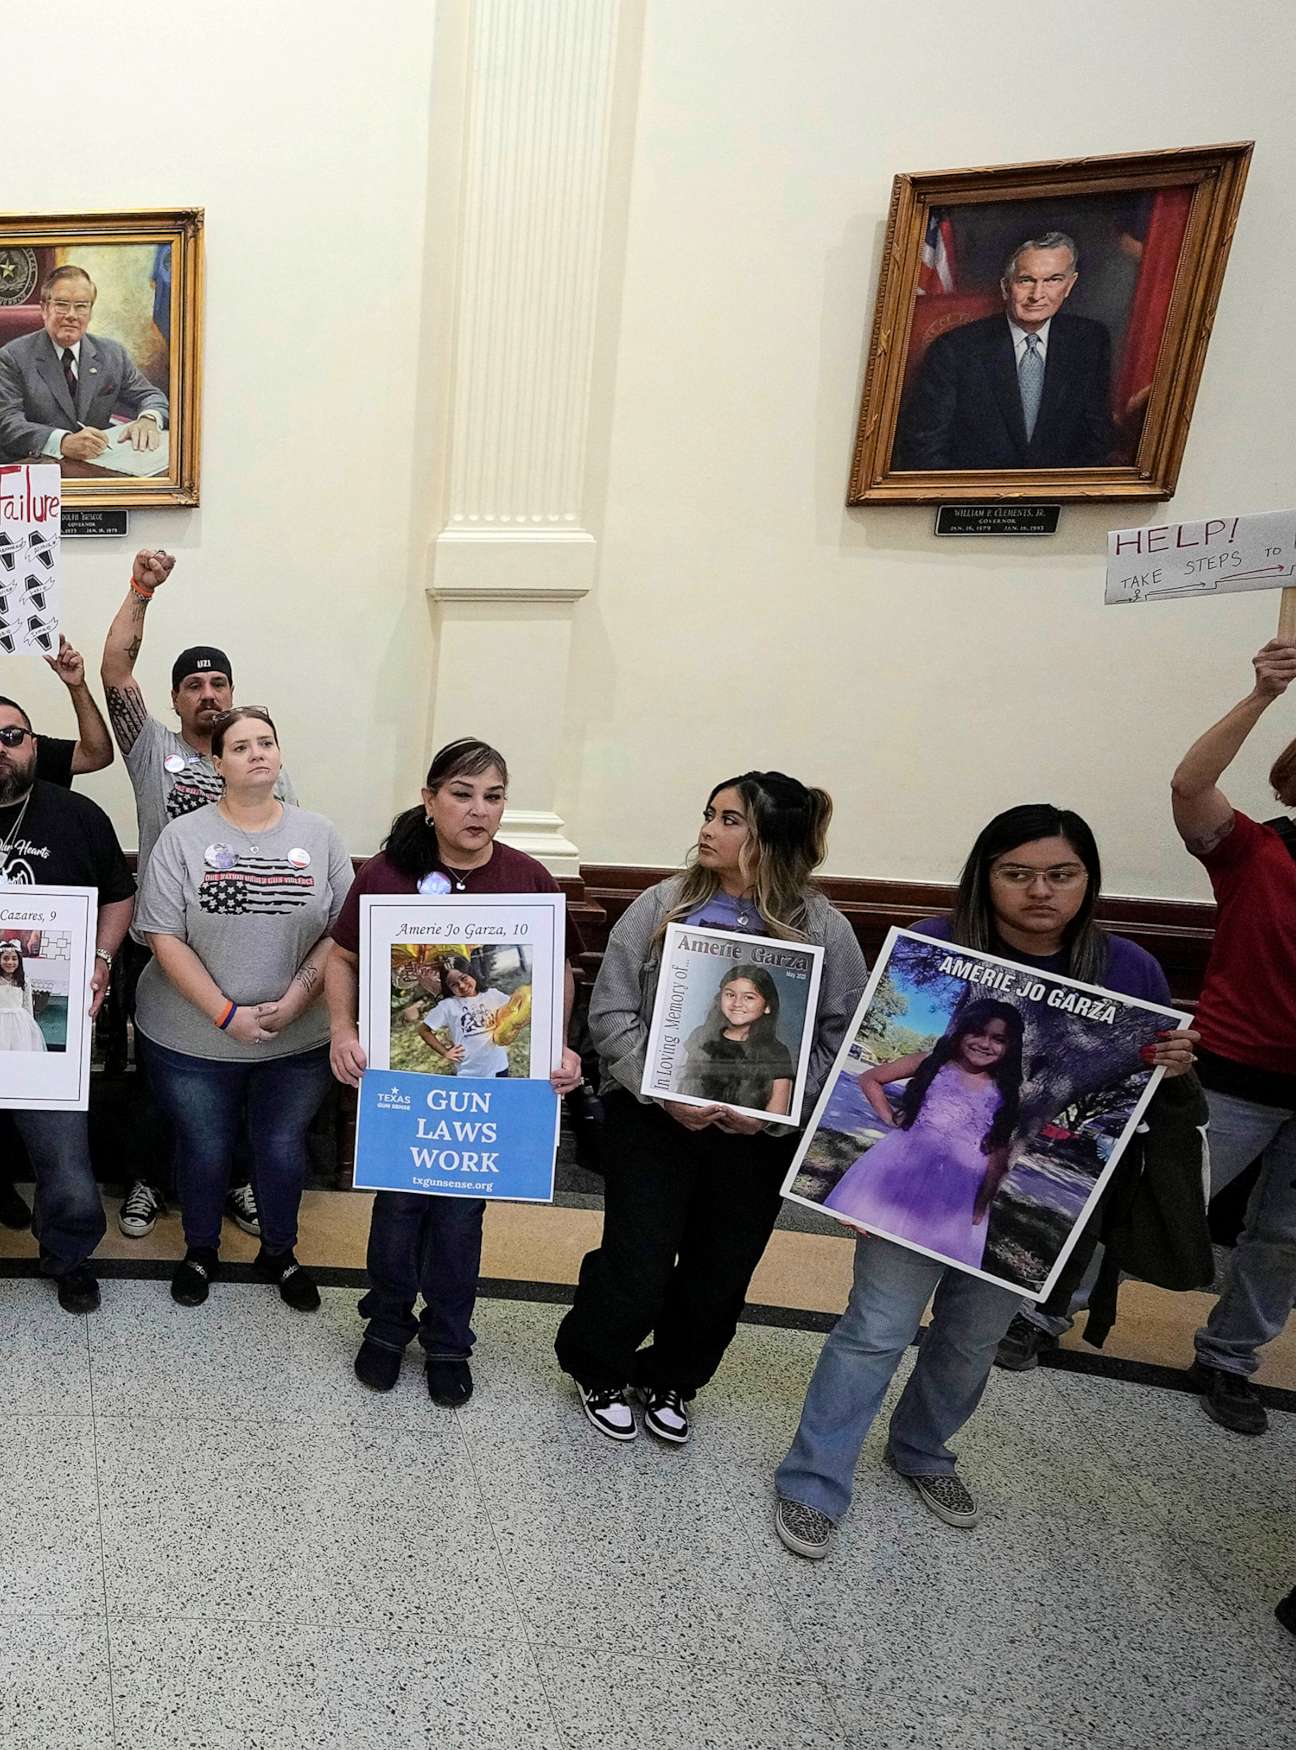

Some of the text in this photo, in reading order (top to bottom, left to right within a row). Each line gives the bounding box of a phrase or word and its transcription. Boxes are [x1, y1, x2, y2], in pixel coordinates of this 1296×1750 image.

[954, 508, 985, 517] WILLIAM
[1115, 517, 1240, 556] HELP!
[1120, 547, 1282, 590] TAKE STEPS TO
[197, 659, 211, 668] UZI
[14, 839, 51, 860] Hearts
[284, 876, 314, 886] VIOLENCE
[0, 909, 45, 923] Cazares,
[50, 910, 57, 921] 9
[395, 922, 529, 939] Amerie Jo Garza, 10
[678, 935, 809, 971] Amerie Garza
[938, 956, 1117, 1025] AMERIE JO GARZA
[665, 982, 689, 1030] Memory
[656, 1036, 680, 1078] Loving
[654, 1070, 669, 1090] In
[377, 1093, 411, 1104] TEXAS
[427, 1089, 492, 1113] GUN
[416, 1118, 497, 1143] LAWS
[410, 1147, 499, 1173] WORK
[412, 1176, 494, 1192] txgunsense.org
